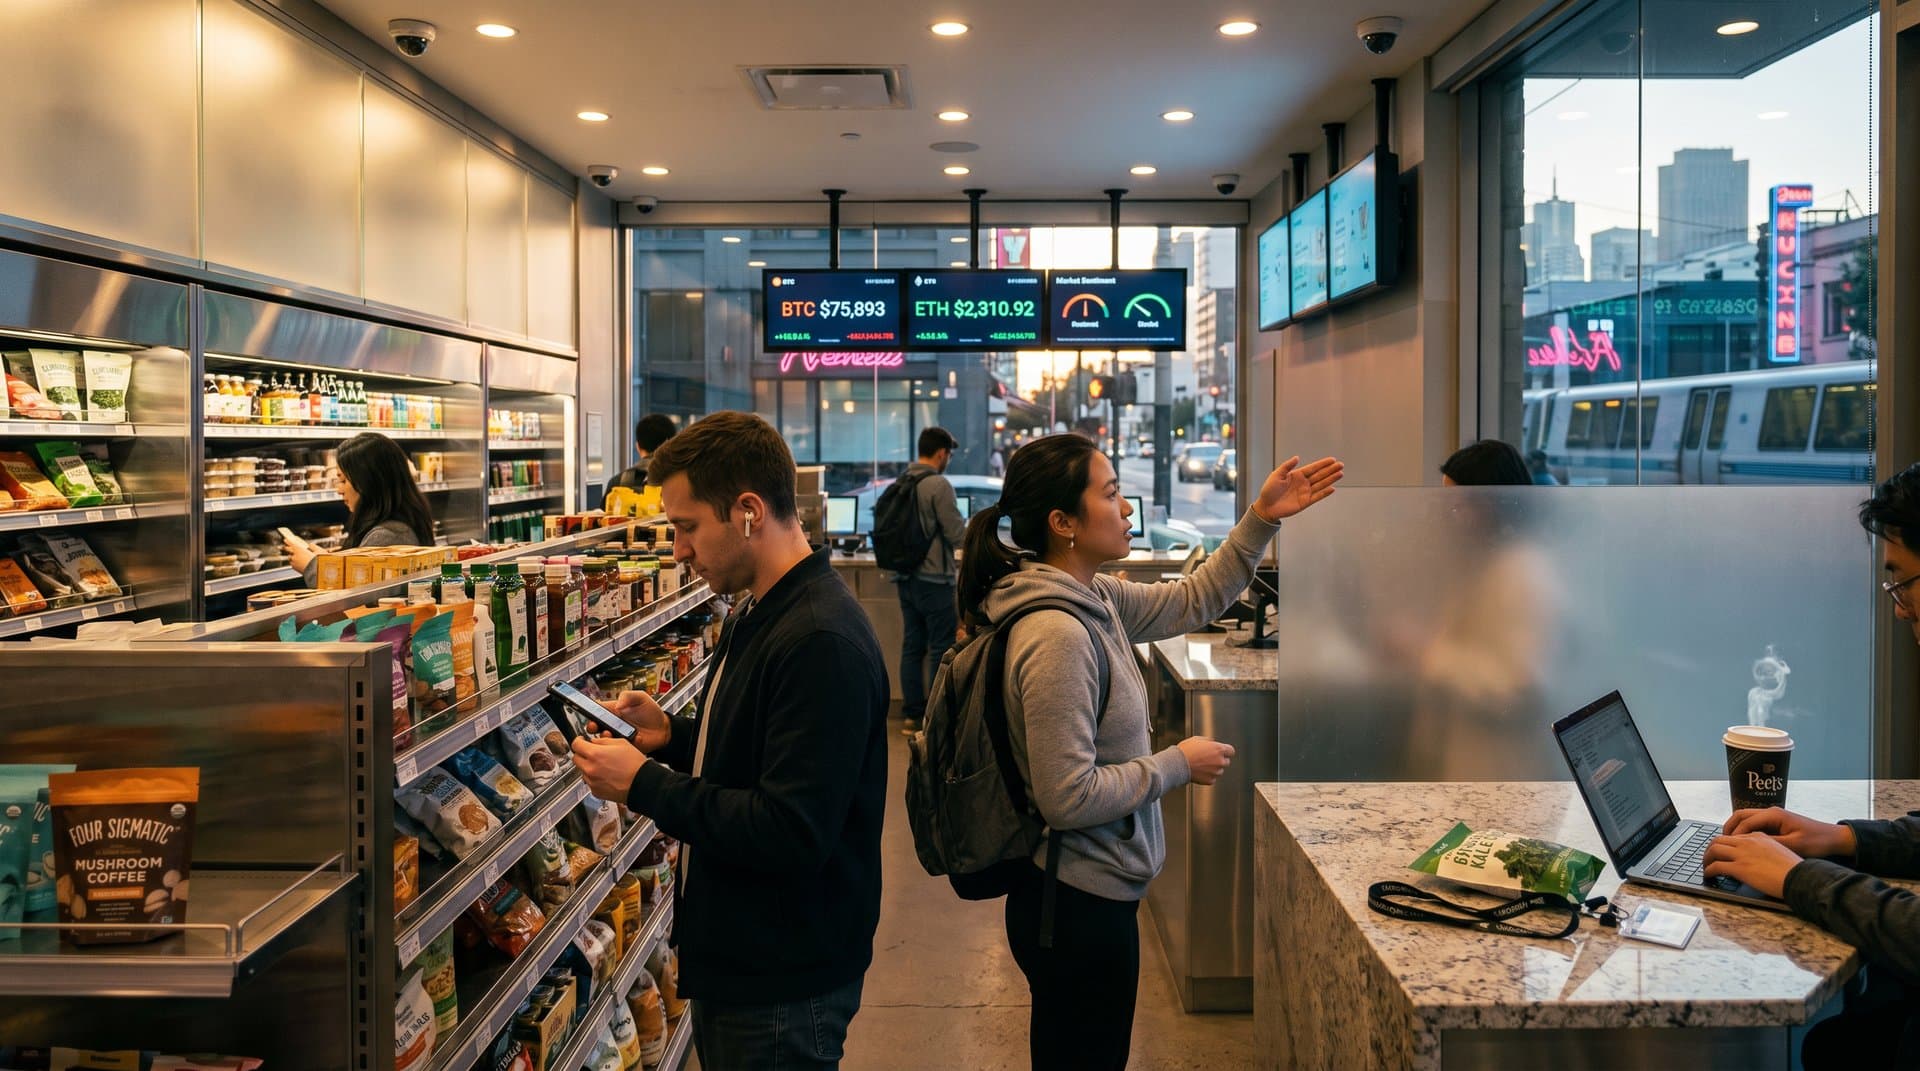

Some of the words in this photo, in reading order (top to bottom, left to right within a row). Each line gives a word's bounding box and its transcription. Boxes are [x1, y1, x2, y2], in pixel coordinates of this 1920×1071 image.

[782, 301, 816, 317] BTC
[819, 299, 886, 319] $75,893
[915, 301, 949, 316] ETH
[953, 299, 1035, 319] $2,310.92
[1746, 770, 1783, 792] Peet's
[69, 819, 103, 848] FOUR
[107, 817, 175, 845] SIGMATIC
[75, 857, 163, 871] MUSHROOM
[1470, 840, 1494, 870] KALE
[87, 871, 147, 884] COFFEE
